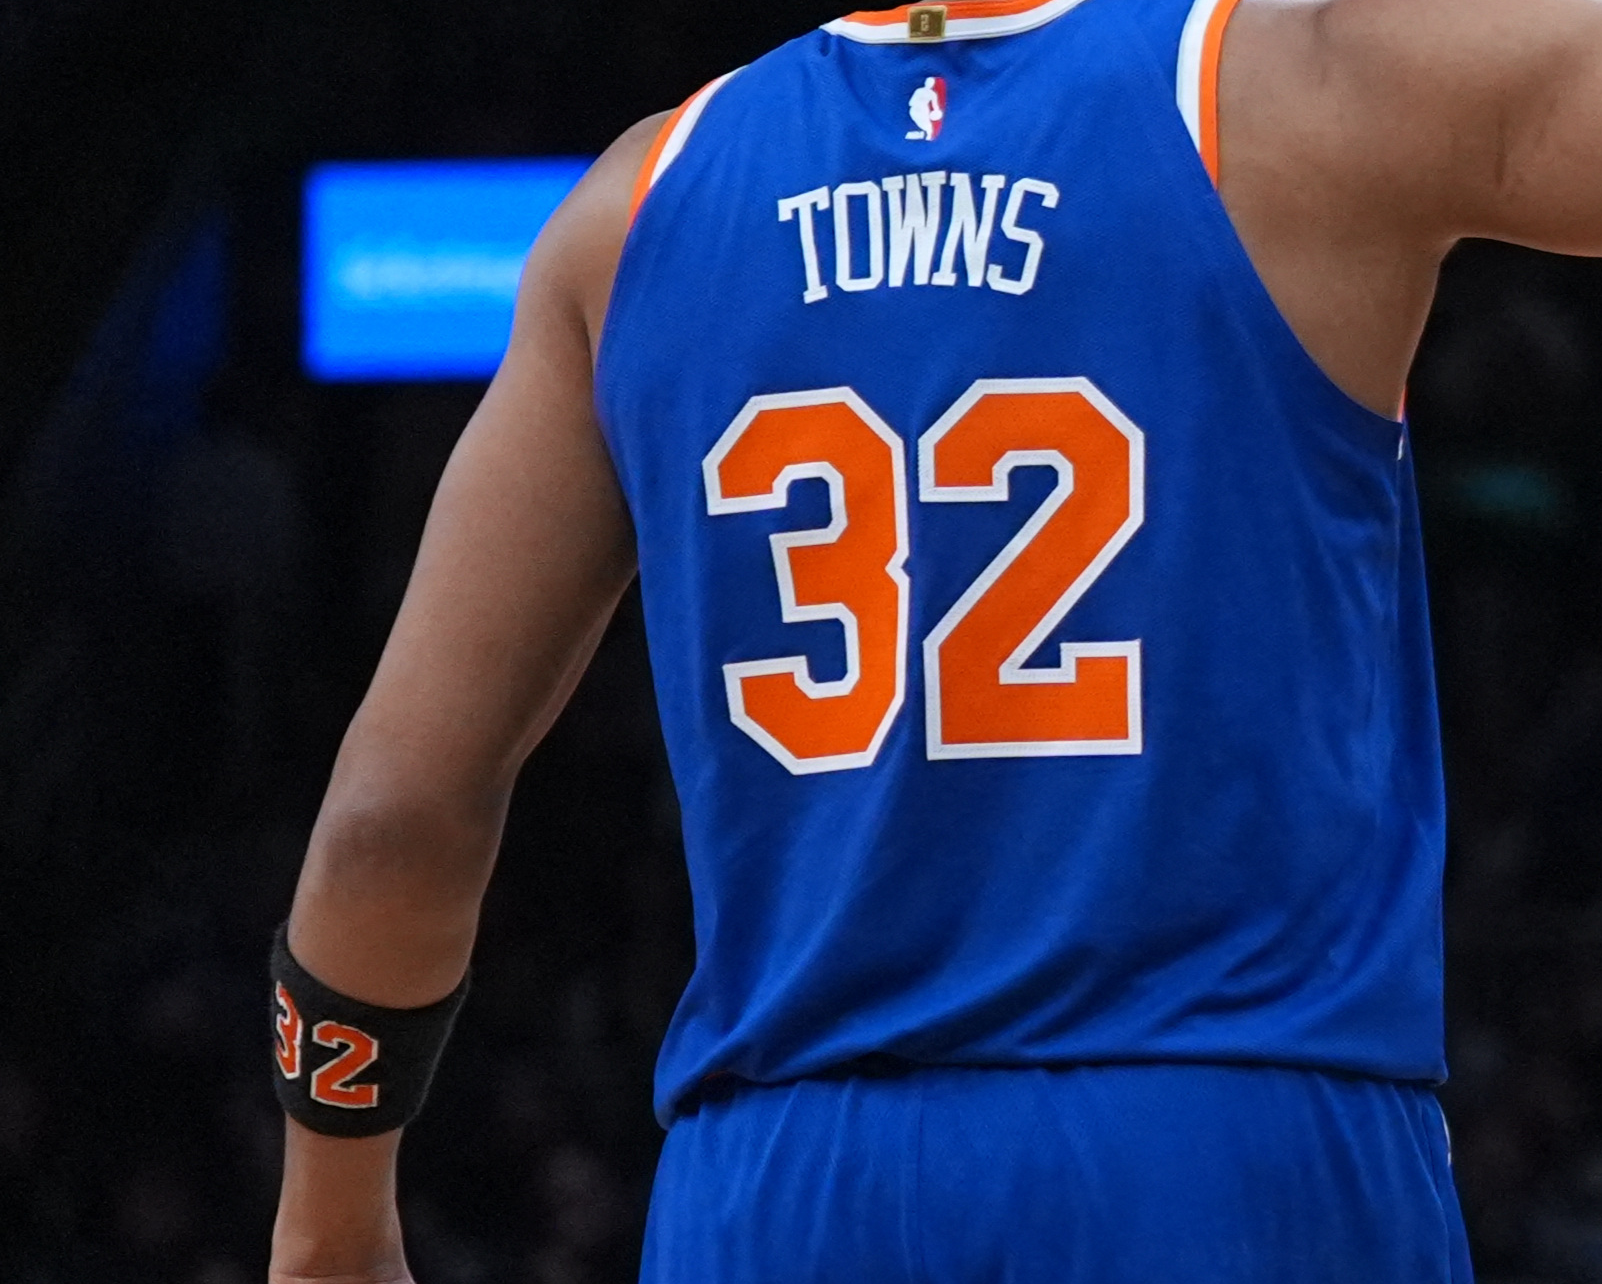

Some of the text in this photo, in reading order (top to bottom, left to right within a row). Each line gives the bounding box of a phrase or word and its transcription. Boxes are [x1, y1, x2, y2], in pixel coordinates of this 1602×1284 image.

[778, 170, 1060, 304] TOWNS
[702, 377, 1146, 775] 32
[275, 980, 379, 1109] 32
